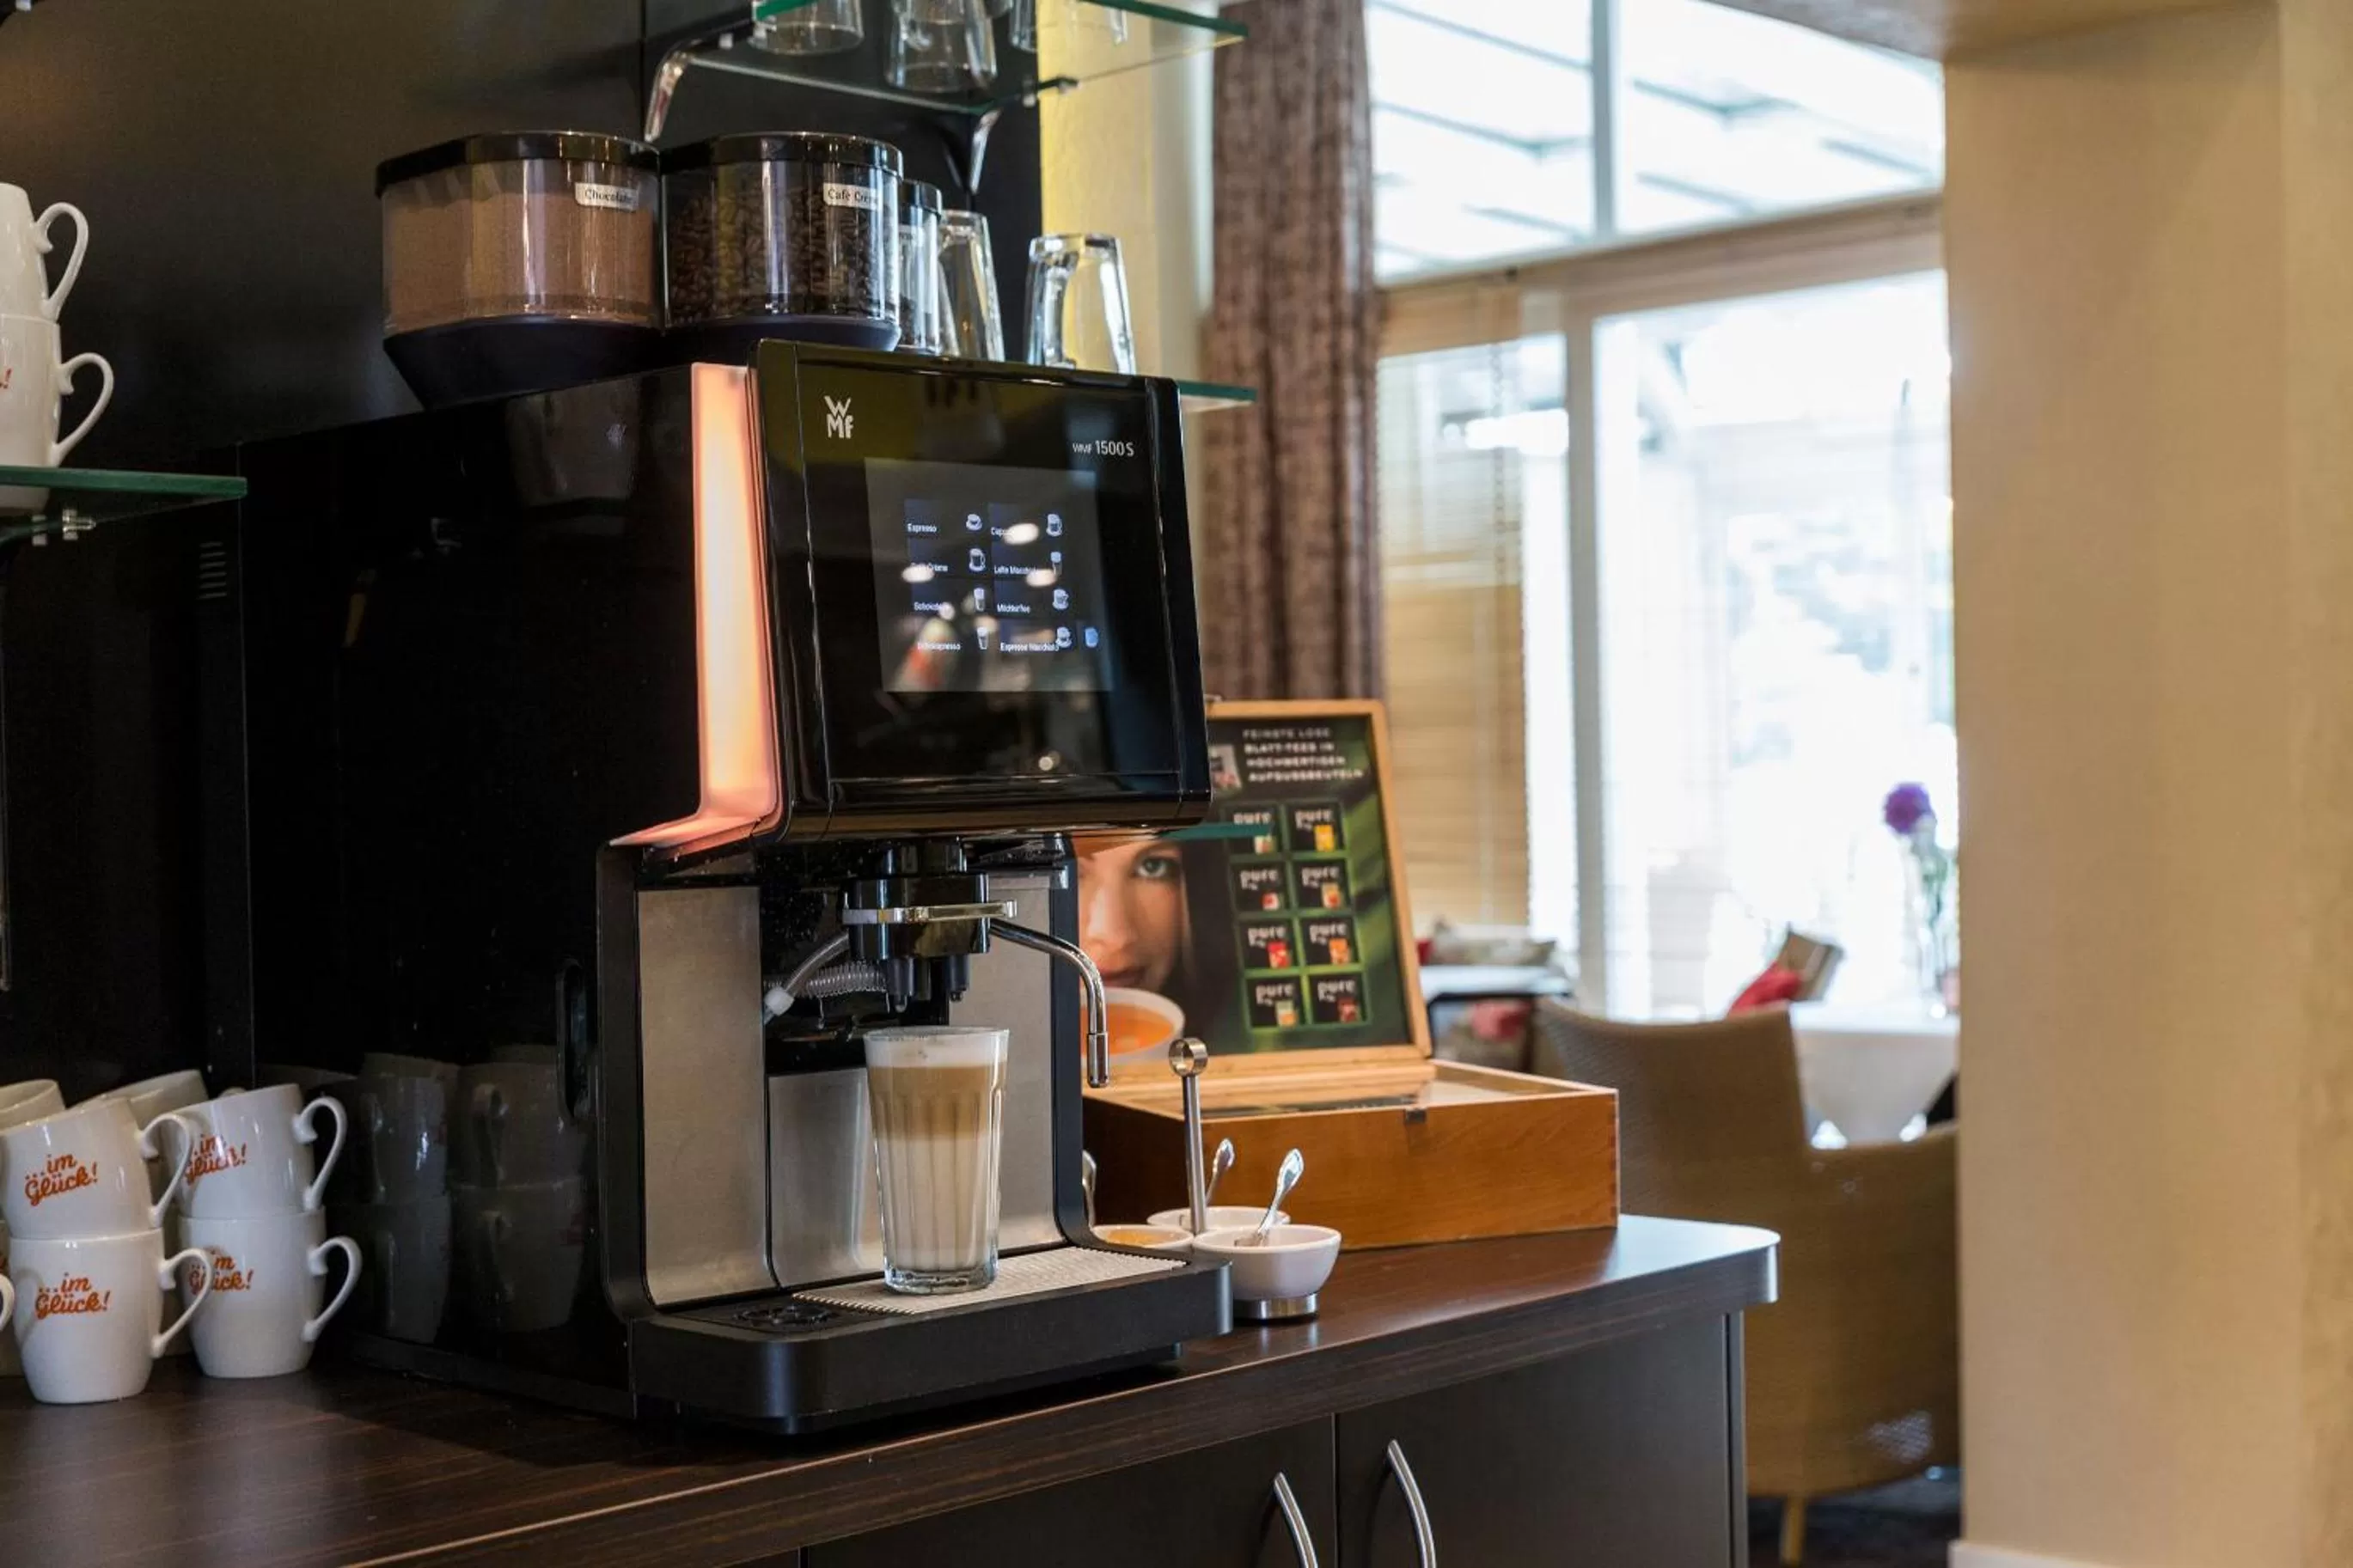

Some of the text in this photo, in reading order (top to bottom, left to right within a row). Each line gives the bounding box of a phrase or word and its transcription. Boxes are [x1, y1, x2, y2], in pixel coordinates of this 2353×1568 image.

[908, 523, 938, 533] Espresso
[24, 1162, 98, 1206] Glück!
[35, 1290, 110, 1320] Glück!
